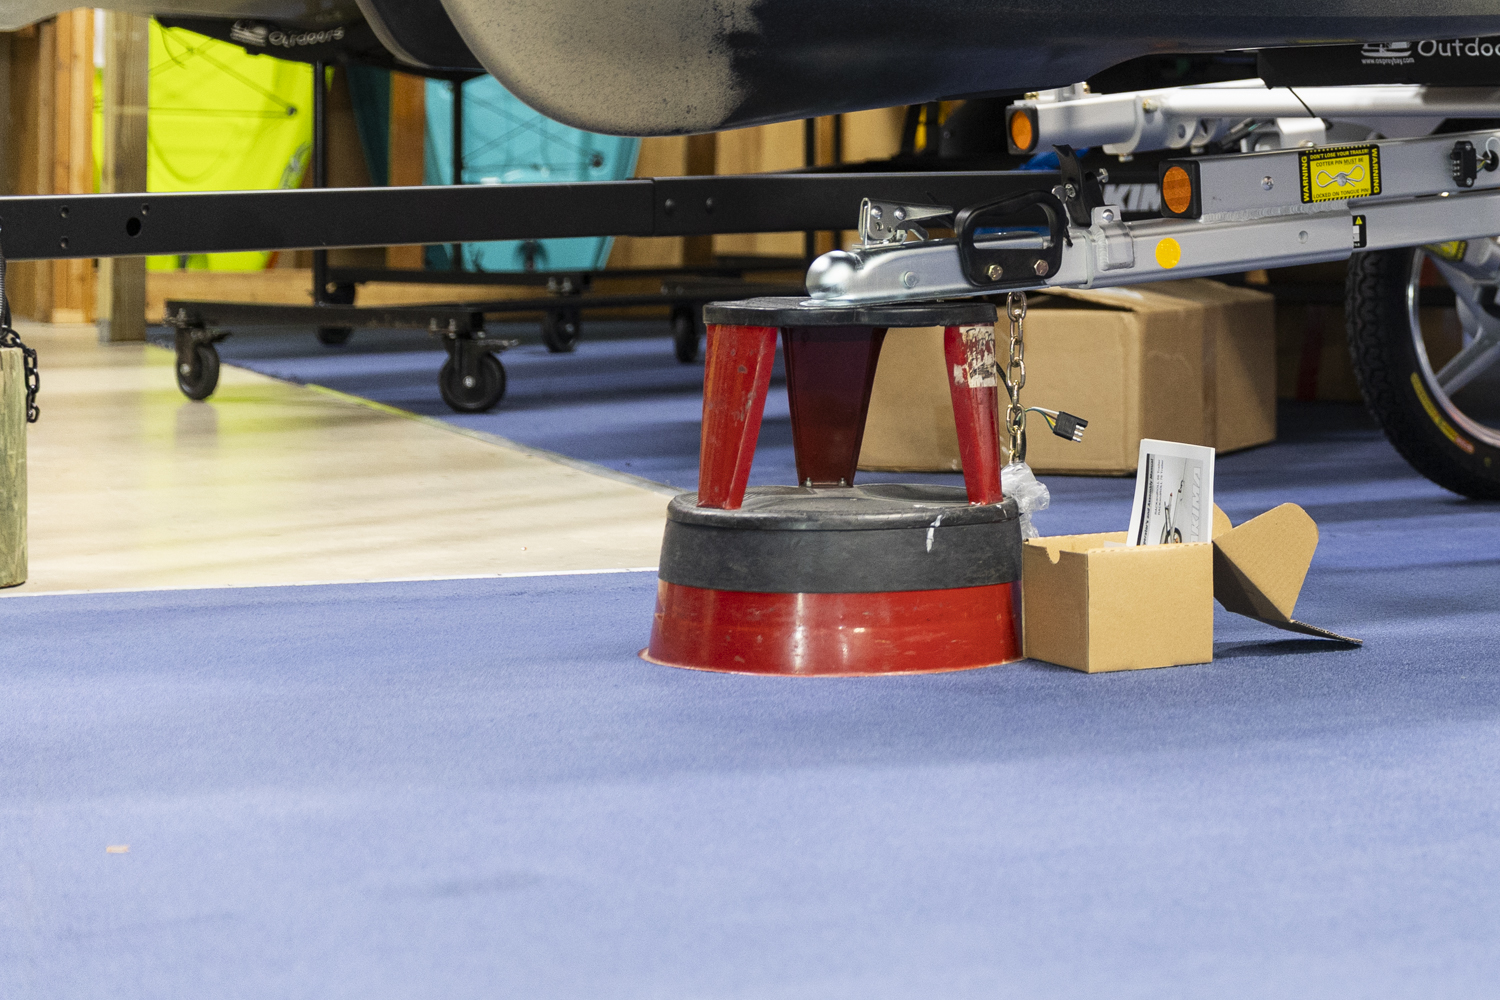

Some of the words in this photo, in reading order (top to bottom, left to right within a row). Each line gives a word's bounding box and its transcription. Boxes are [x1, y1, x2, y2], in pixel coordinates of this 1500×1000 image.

[1361, 57, 1415, 66] www.ospreybay.com
[1301, 156, 1310, 202] WARNING
[1371, 148, 1380, 193] WARNING
[1102, 184, 1160, 213] KIM
